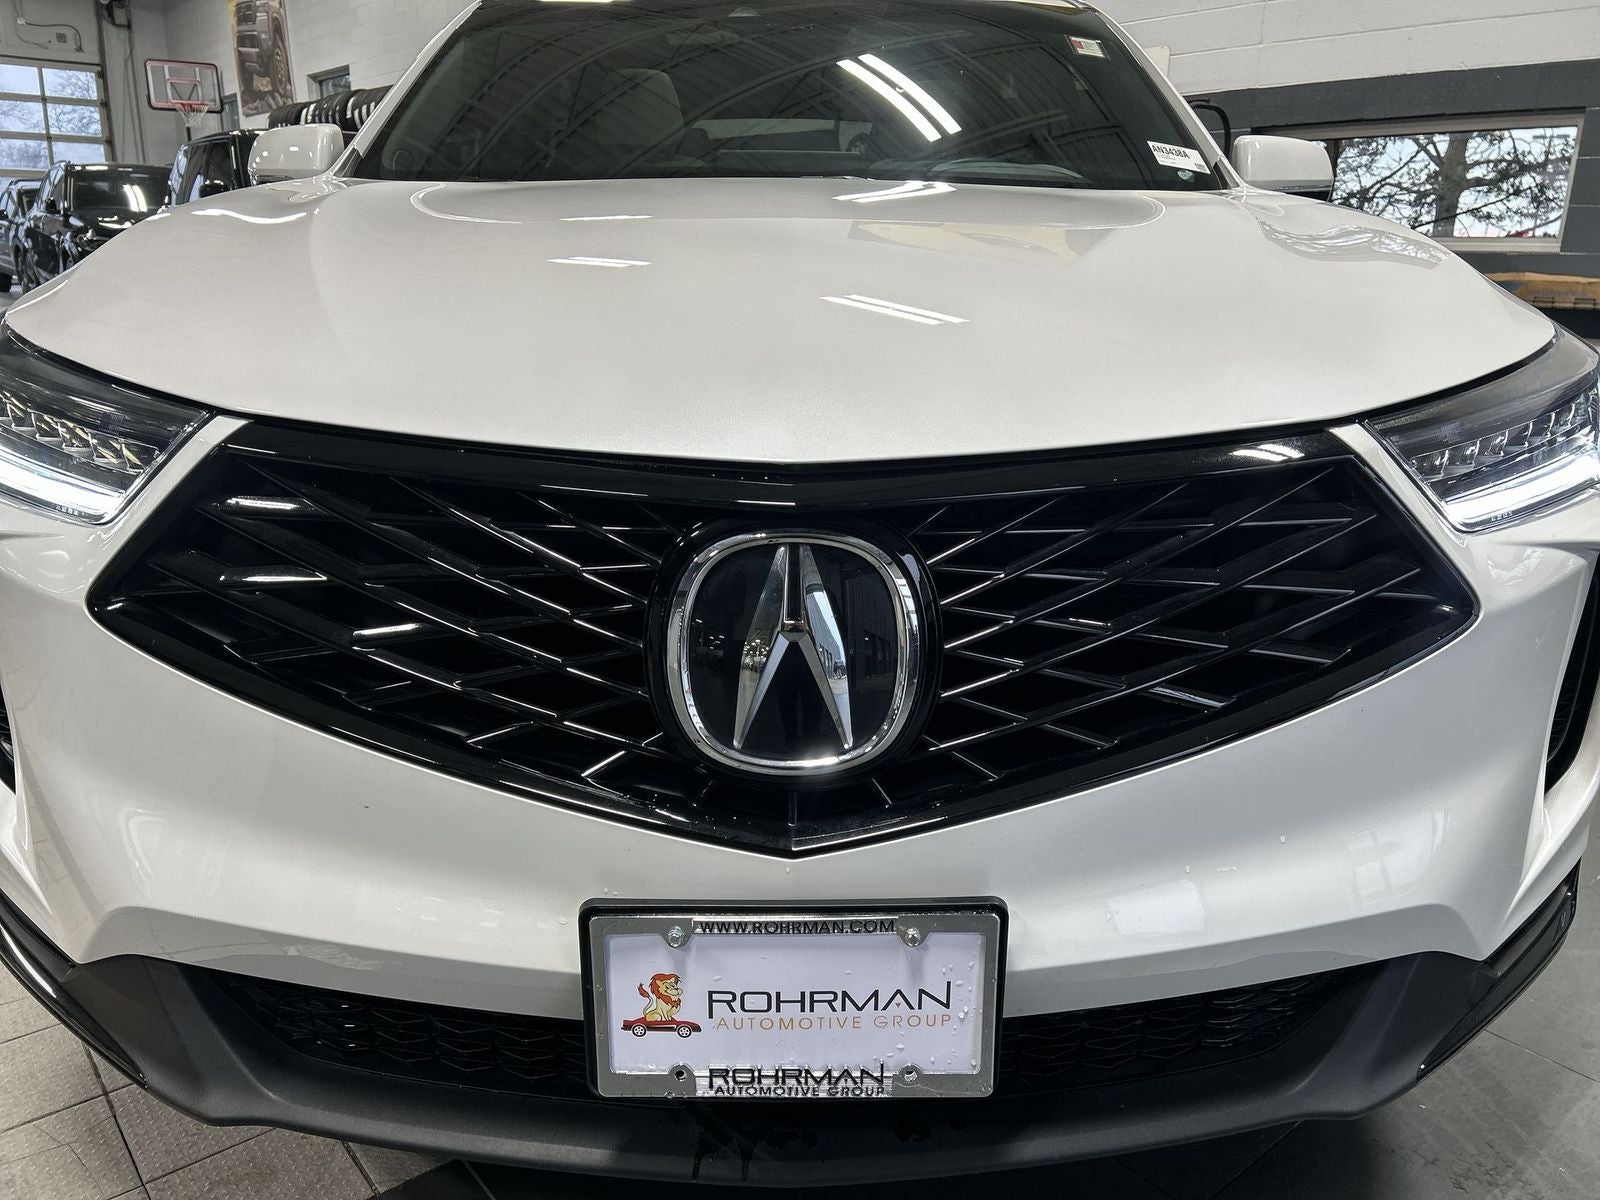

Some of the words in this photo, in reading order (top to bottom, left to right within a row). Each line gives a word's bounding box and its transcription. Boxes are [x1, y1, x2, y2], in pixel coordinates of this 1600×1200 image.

[700, 919, 895, 934] WWW.ROHRMAN.COM
[708, 981, 950, 1019] ROHRMAN
[716, 1017, 862, 1031] AUTOMOTIVE
[873, 1014, 951, 1029] GROUP
[709, 1060, 884, 1090] ROHRMAN
[714, 1086, 819, 1097] AUTOMOTIVE
[827, 1086, 884, 1097] GROUP
